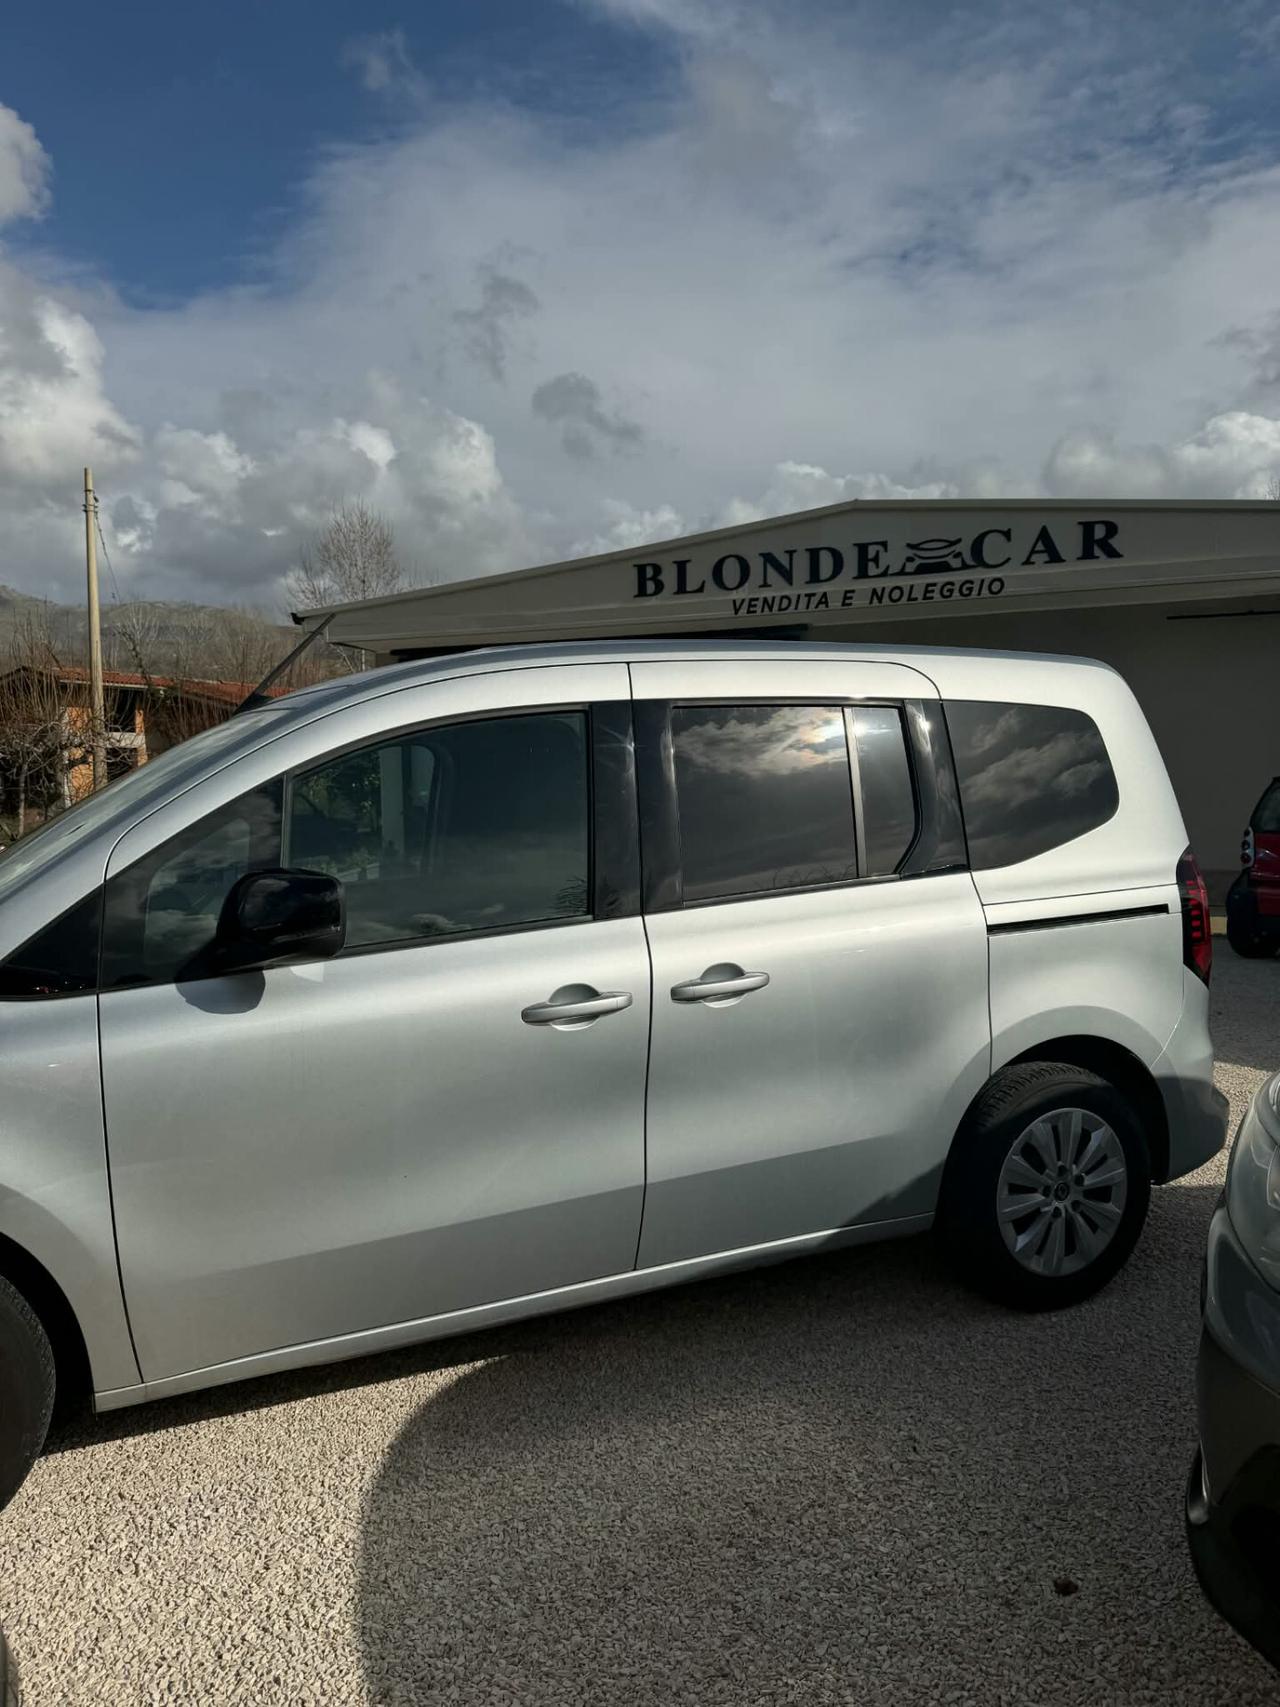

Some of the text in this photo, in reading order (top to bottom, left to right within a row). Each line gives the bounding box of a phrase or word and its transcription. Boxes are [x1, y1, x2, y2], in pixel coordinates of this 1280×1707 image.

[633, 519, 1124, 598] BLONDE CAR
[731, 577, 1006, 616] VENDITA E NOLEGGIO
